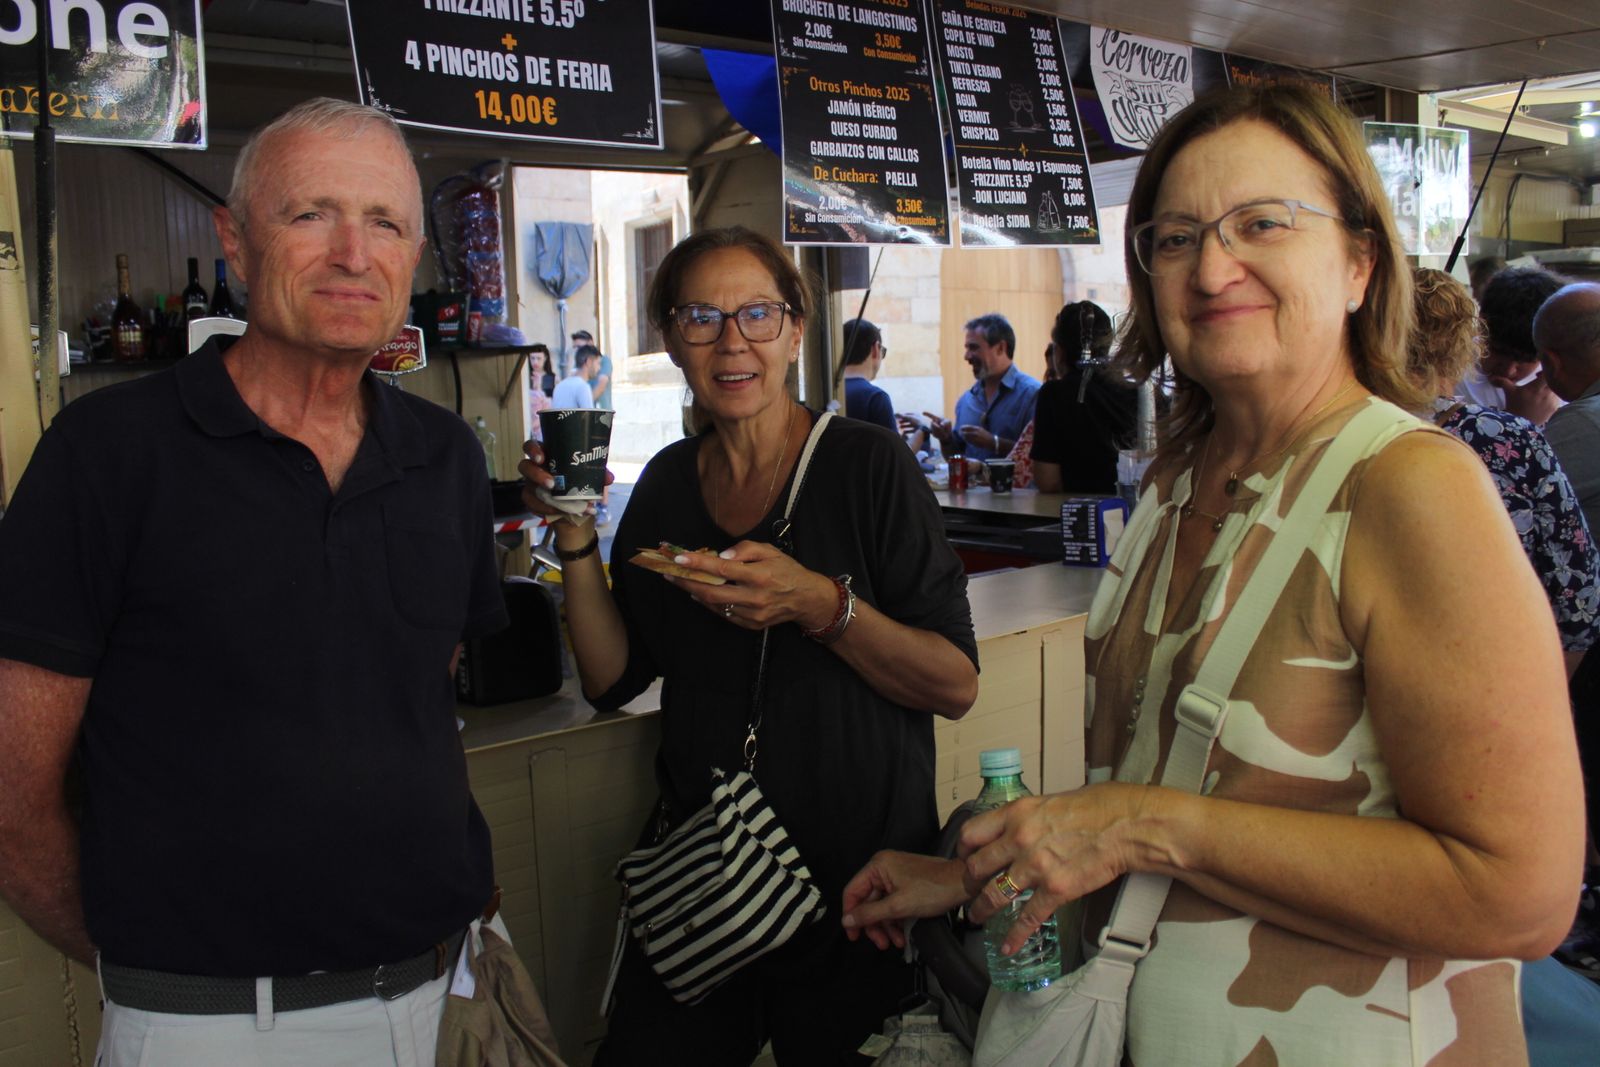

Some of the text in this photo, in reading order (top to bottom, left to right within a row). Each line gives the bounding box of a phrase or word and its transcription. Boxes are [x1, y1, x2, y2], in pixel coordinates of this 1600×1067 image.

[838, 4, 851, 21] DE
[853, 7, 918, 32] LANGOSTINOS
[941, 10, 1052, 41] CAÑA DE CERVEZA 2,00€
[501, 33, 518, 50] +
[793, 36, 804, 47] Sin
[805, 22, 833, 39] 2,00€
[875, 33, 902, 49] 3,50€
[944, 27, 1055, 57] COPA DE VINO 2,00€
[405, 40, 613, 92] 4 PINCHOS DE FERIA
[946, 44, 1058, 72] MOSTO 2,00€
[1096, 28, 1189, 84] Cerveza
[949, 60, 1062, 87] TINTO VERANO 2,00€
[809, 76, 911, 101] Otros Pinchos 2025
[952, 76, 1065, 102] REFRESCO 2,50€
[475, 89, 558, 126] 14,00€
[828, 99, 897, 120] JAMÓN IBÉRICO
[955, 93, 1067, 117] AGUA 1,50€
[831, 121, 898, 141] QUESO CURADO
[958, 109, 1071, 132] VERMUT 3,50€
[961, 125, 1075, 147] CHISPAZO 4,00€
[810, 141, 919, 163] GARBANZOS CON CALLOS
[813, 165, 918, 187] De Cuchara: PAELLA
[962, 156, 1083, 175] Botella Vino Dulce y Espumoso:
[971, 173, 1015, 188] -FRIZZANTE
[1061, 177, 1083, 191] 7,50€
[896, 198, 923, 214] 3,50€
[972, 190, 1086, 206] -DON LUCIANO 8,00€
[805, 212, 816, 223] Sin
[1006, 214, 1030, 229] SIDRA
[1067, 215, 1090, 229] 7,50€
